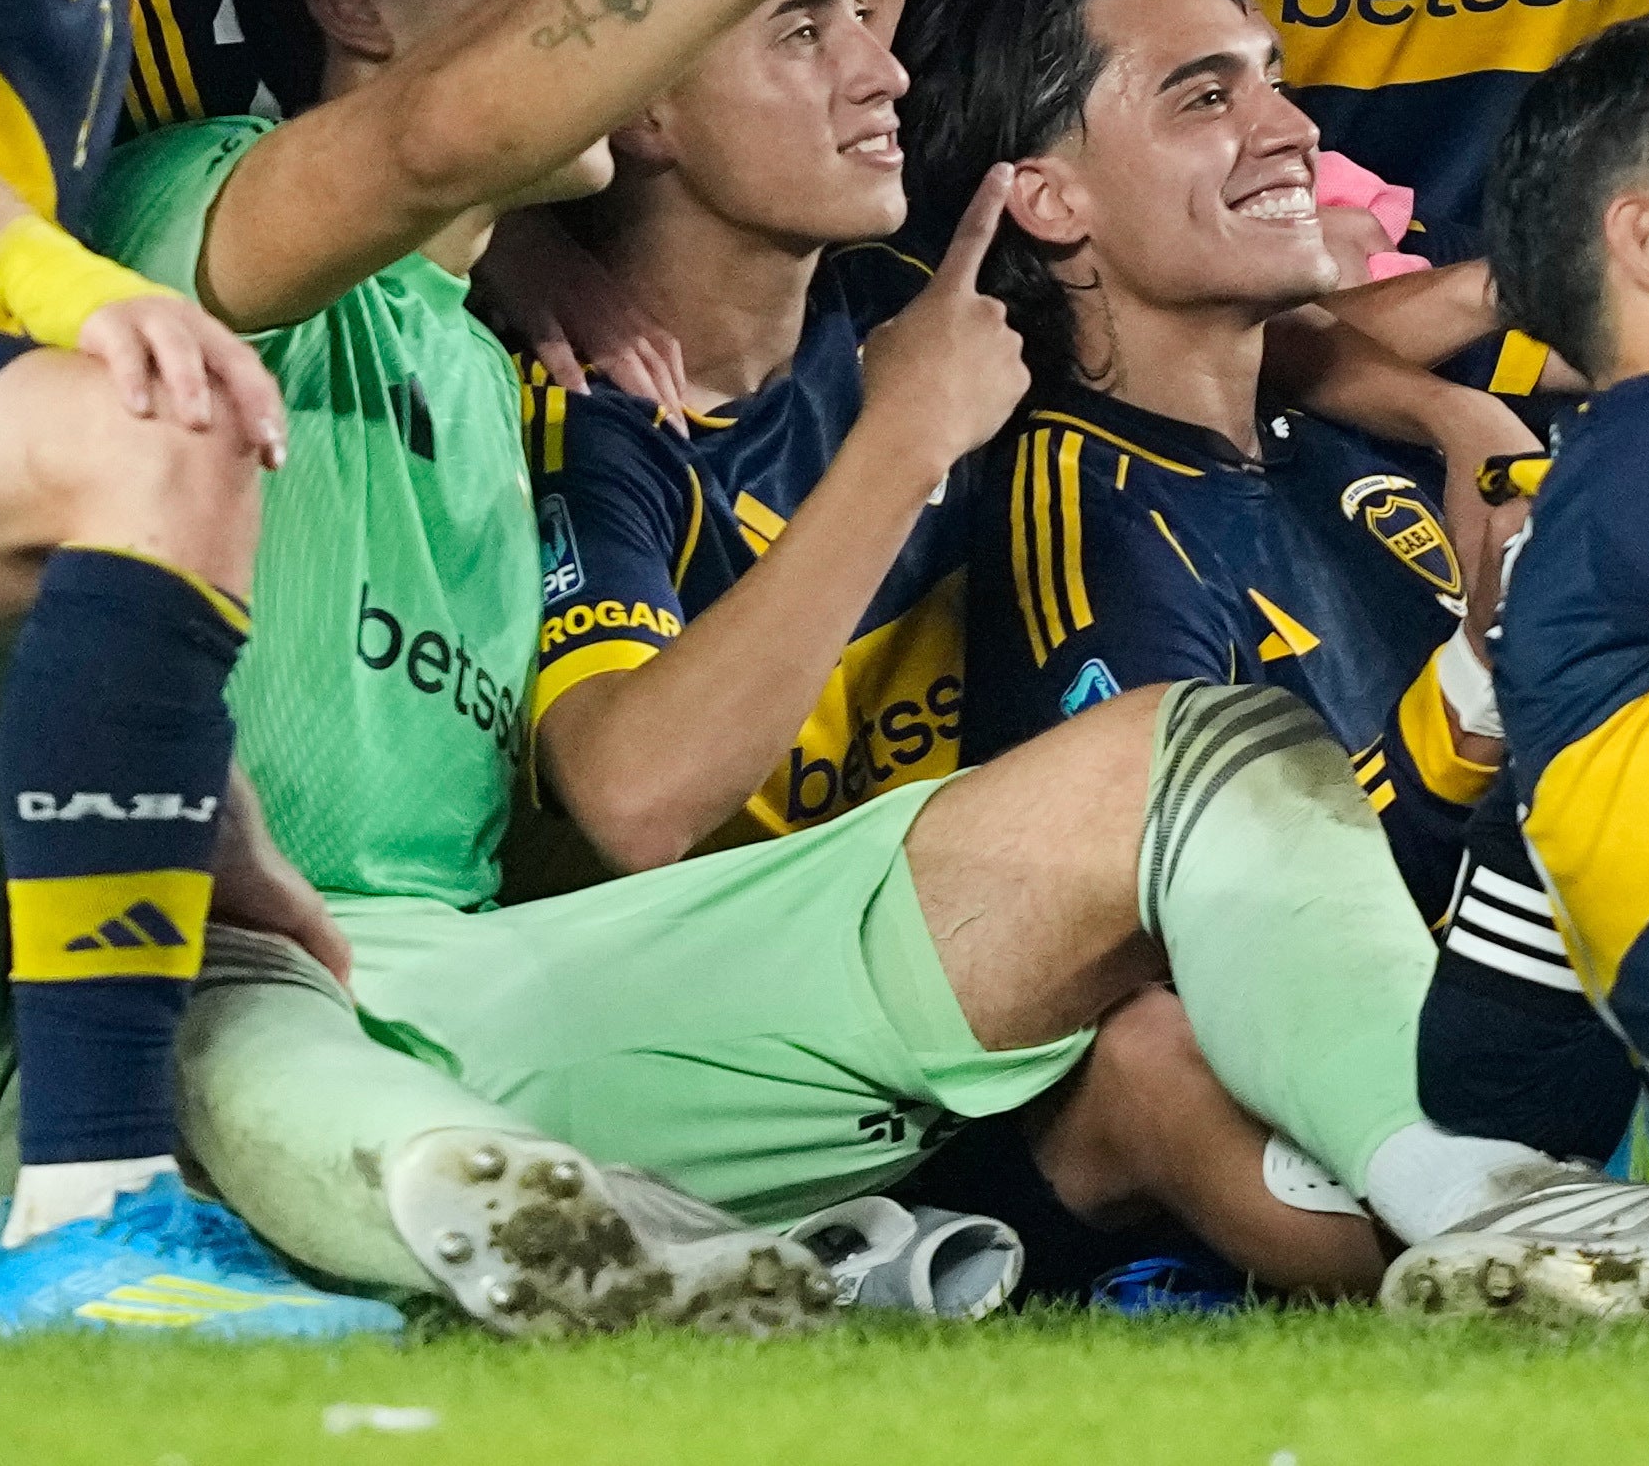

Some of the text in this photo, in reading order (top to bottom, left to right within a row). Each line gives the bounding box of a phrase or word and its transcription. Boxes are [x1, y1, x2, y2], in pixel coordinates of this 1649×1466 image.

[1393, 526, 1435, 556] CABJ
[543, 562, 578, 591] PF
[541, 599, 683, 654] ROGAR
[17, 790, 218, 823] CABJ
